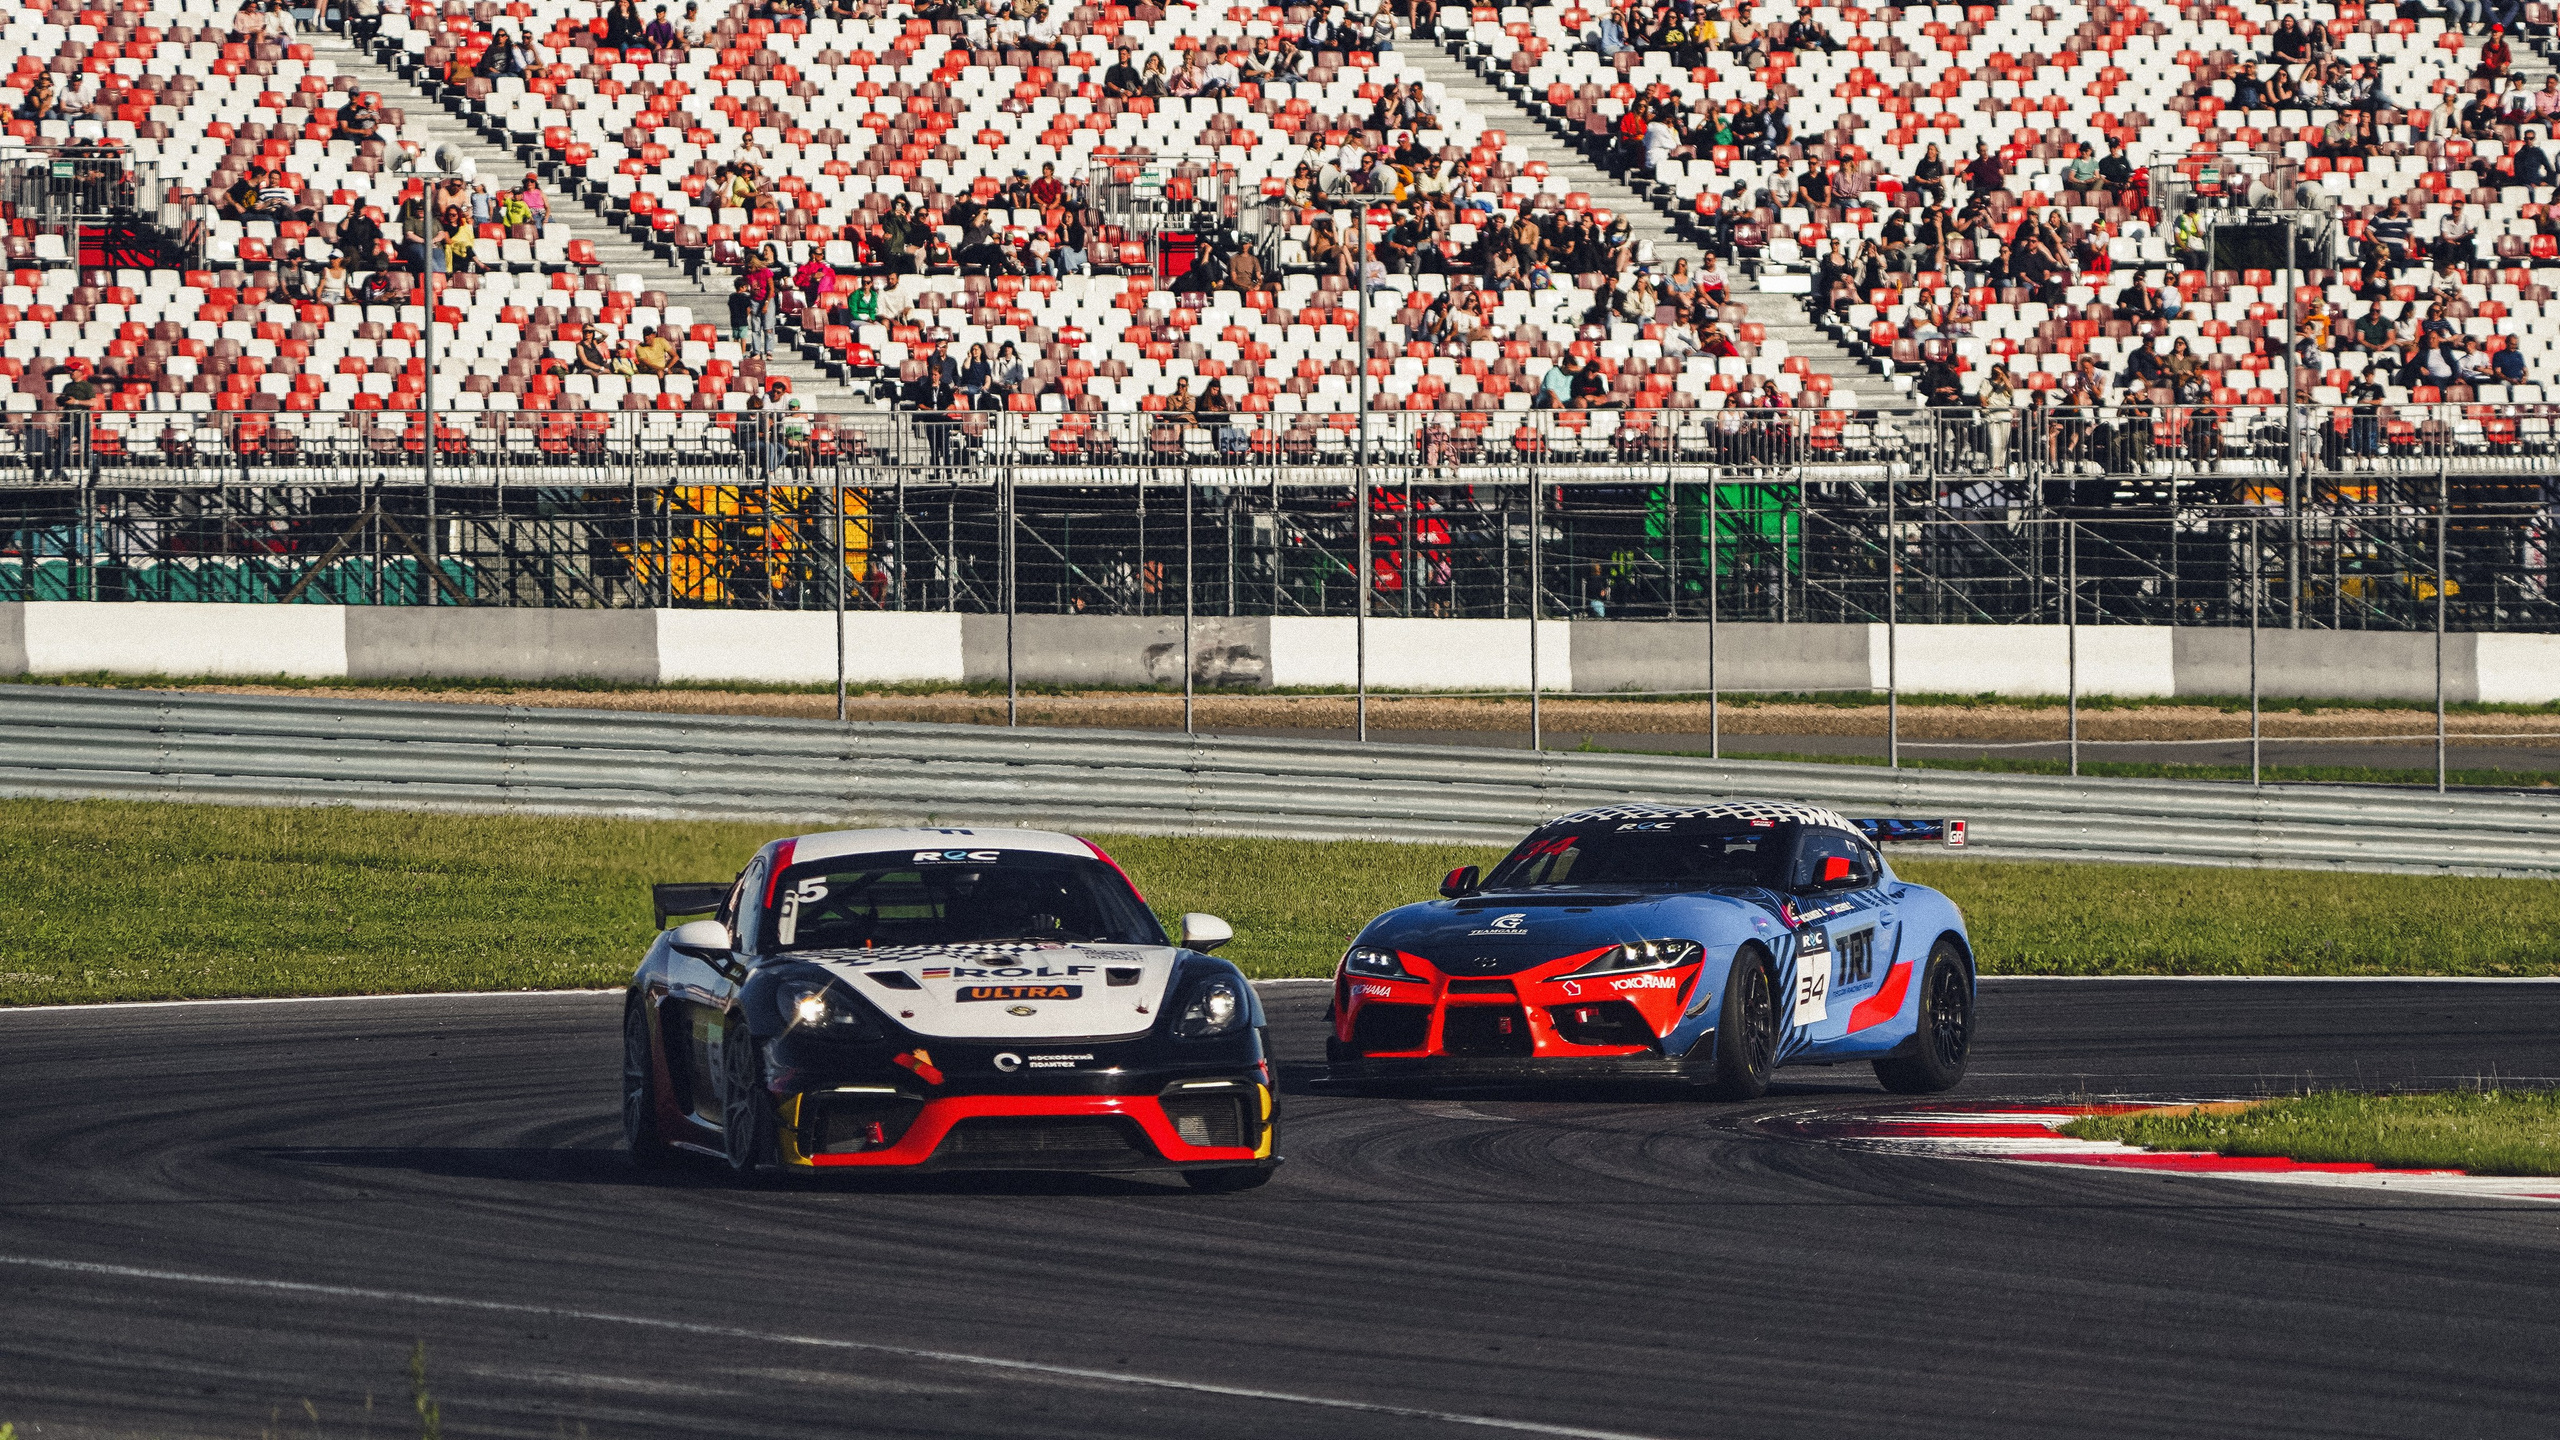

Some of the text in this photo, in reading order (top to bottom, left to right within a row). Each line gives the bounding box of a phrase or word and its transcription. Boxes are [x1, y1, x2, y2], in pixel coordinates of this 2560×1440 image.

[1949, 830, 1964, 843] GR
[1513, 836, 1580, 861] 34
[798, 876, 829, 903] 5
[953, 965, 1096, 978] ROLF
[1609, 976, 1676, 991] YOKOHAMA
[1800, 973, 1825, 1006] 34
[971, 986, 1070, 999] ULTRA
